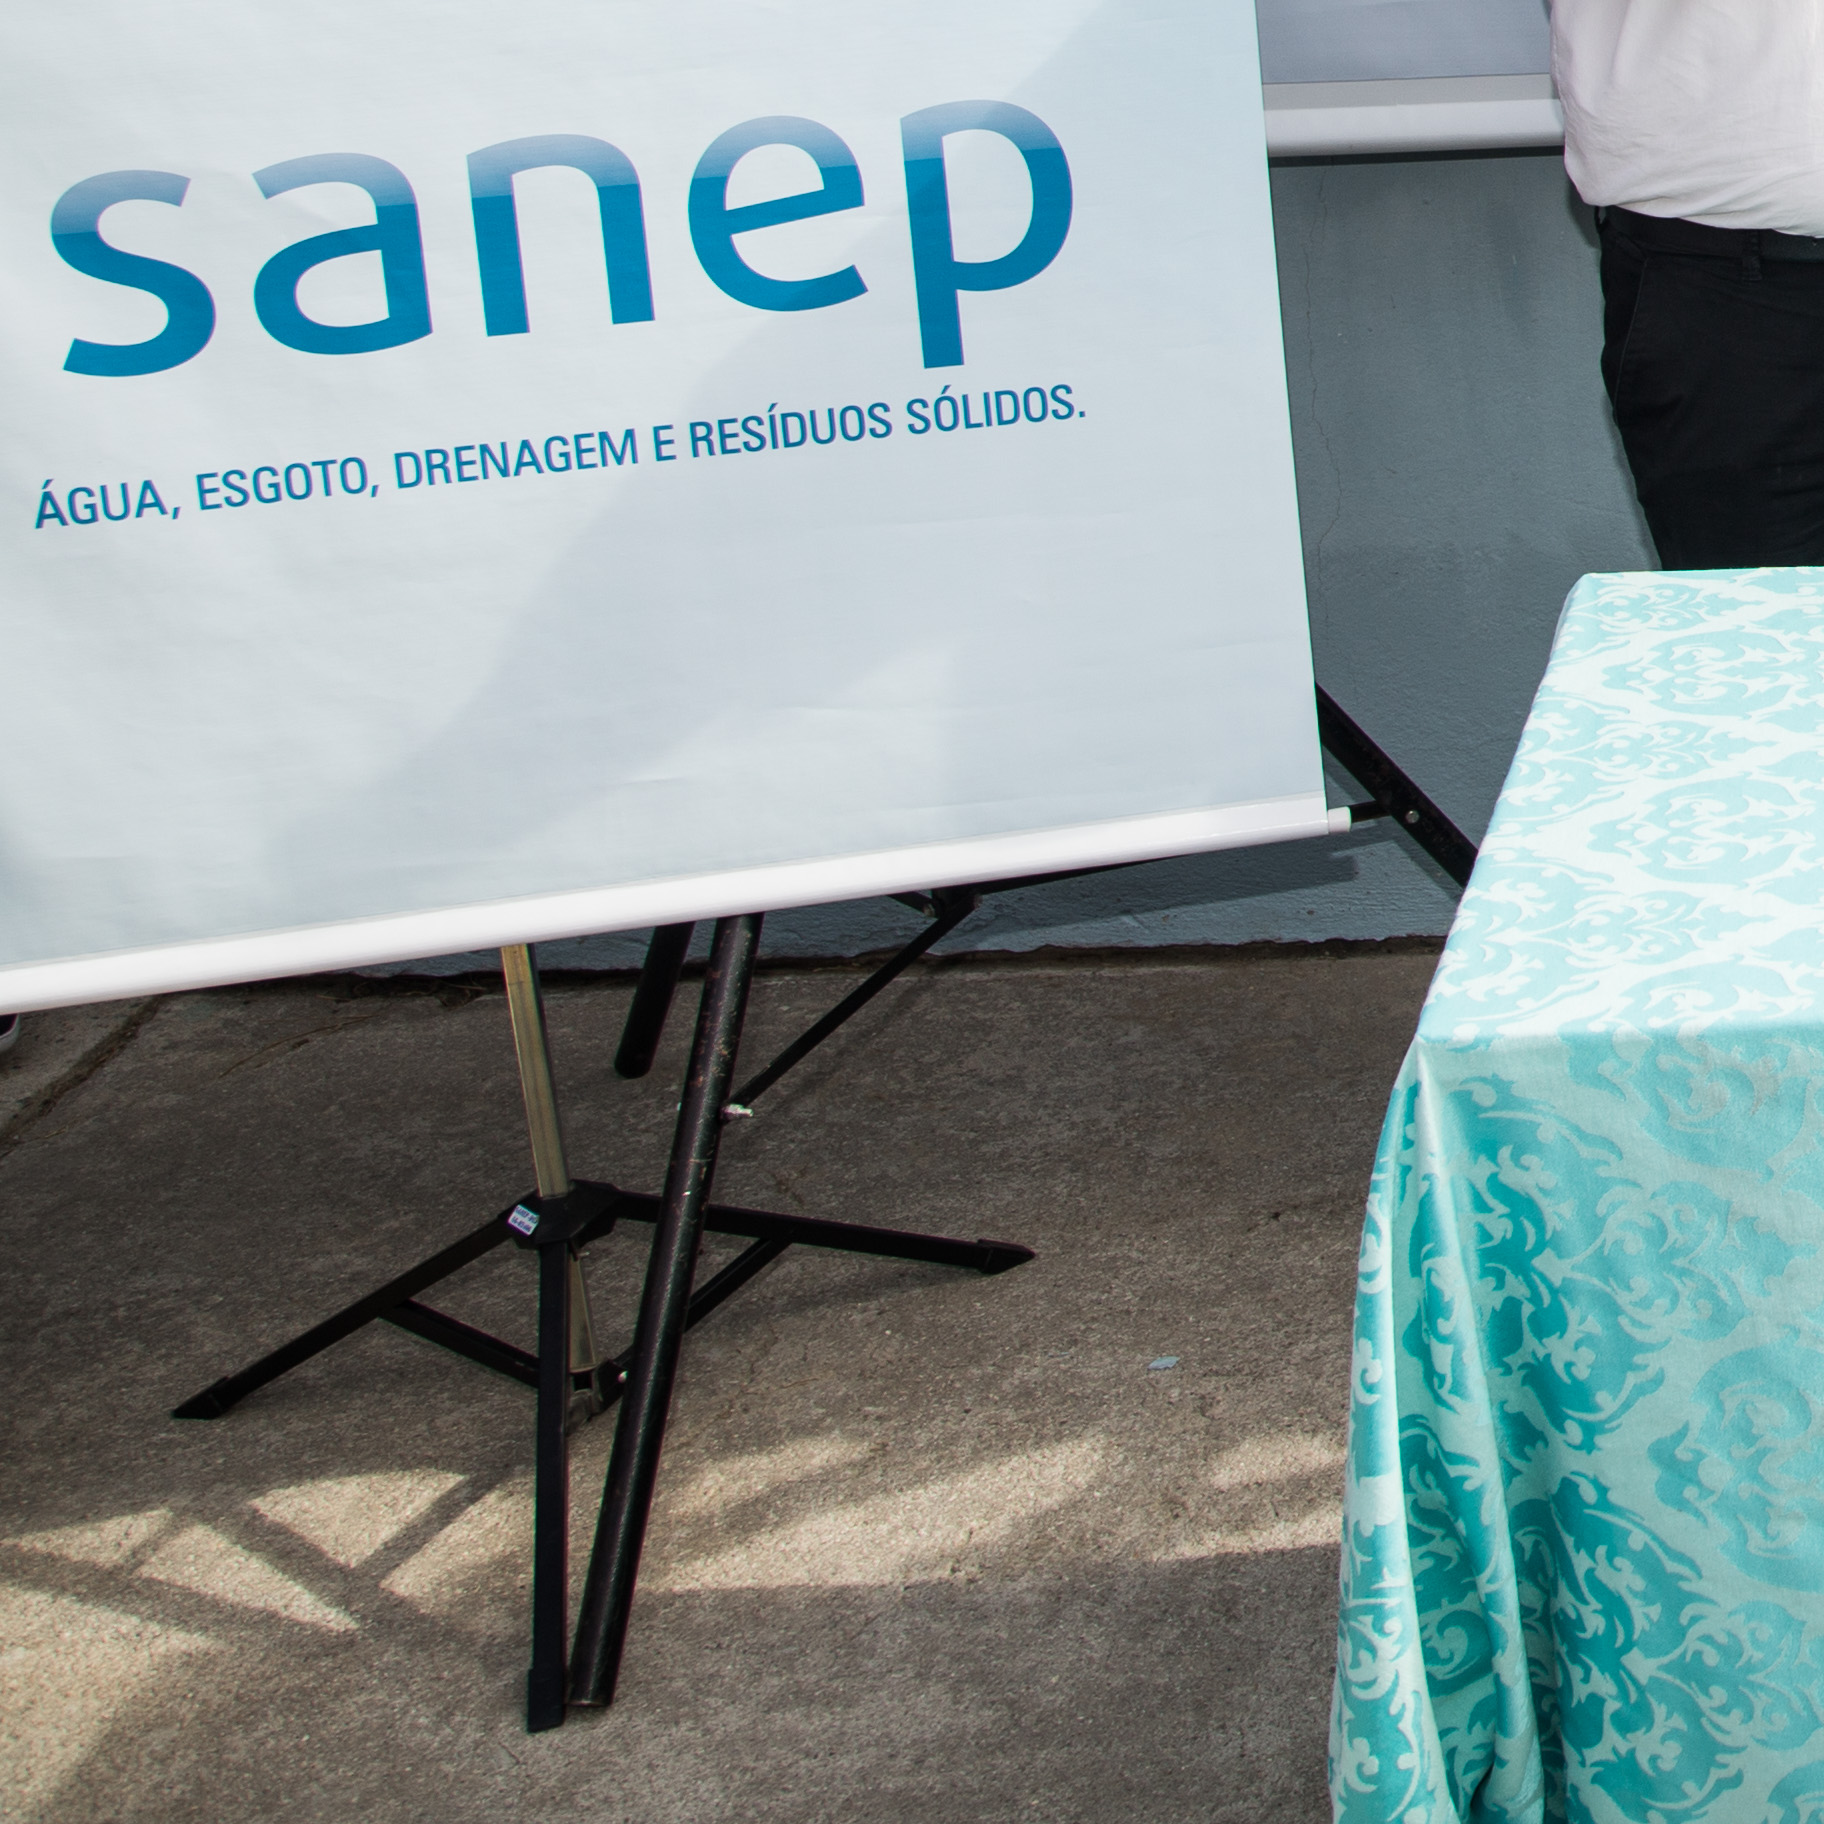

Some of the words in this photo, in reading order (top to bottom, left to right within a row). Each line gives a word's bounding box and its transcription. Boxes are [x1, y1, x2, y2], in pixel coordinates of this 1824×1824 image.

[48, 98, 1075, 379] sanep
[35, 479, 181, 530] ÁGUA,
[195, 456, 381, 512] ESGOTO,
[394, 428, 639, 491] DRENAGEM
[652, 424, 678, 462] E
[689, 402, 894, 458] RESÍDUOS
[906, 383, 1087, 435] SÓLIDOS.
